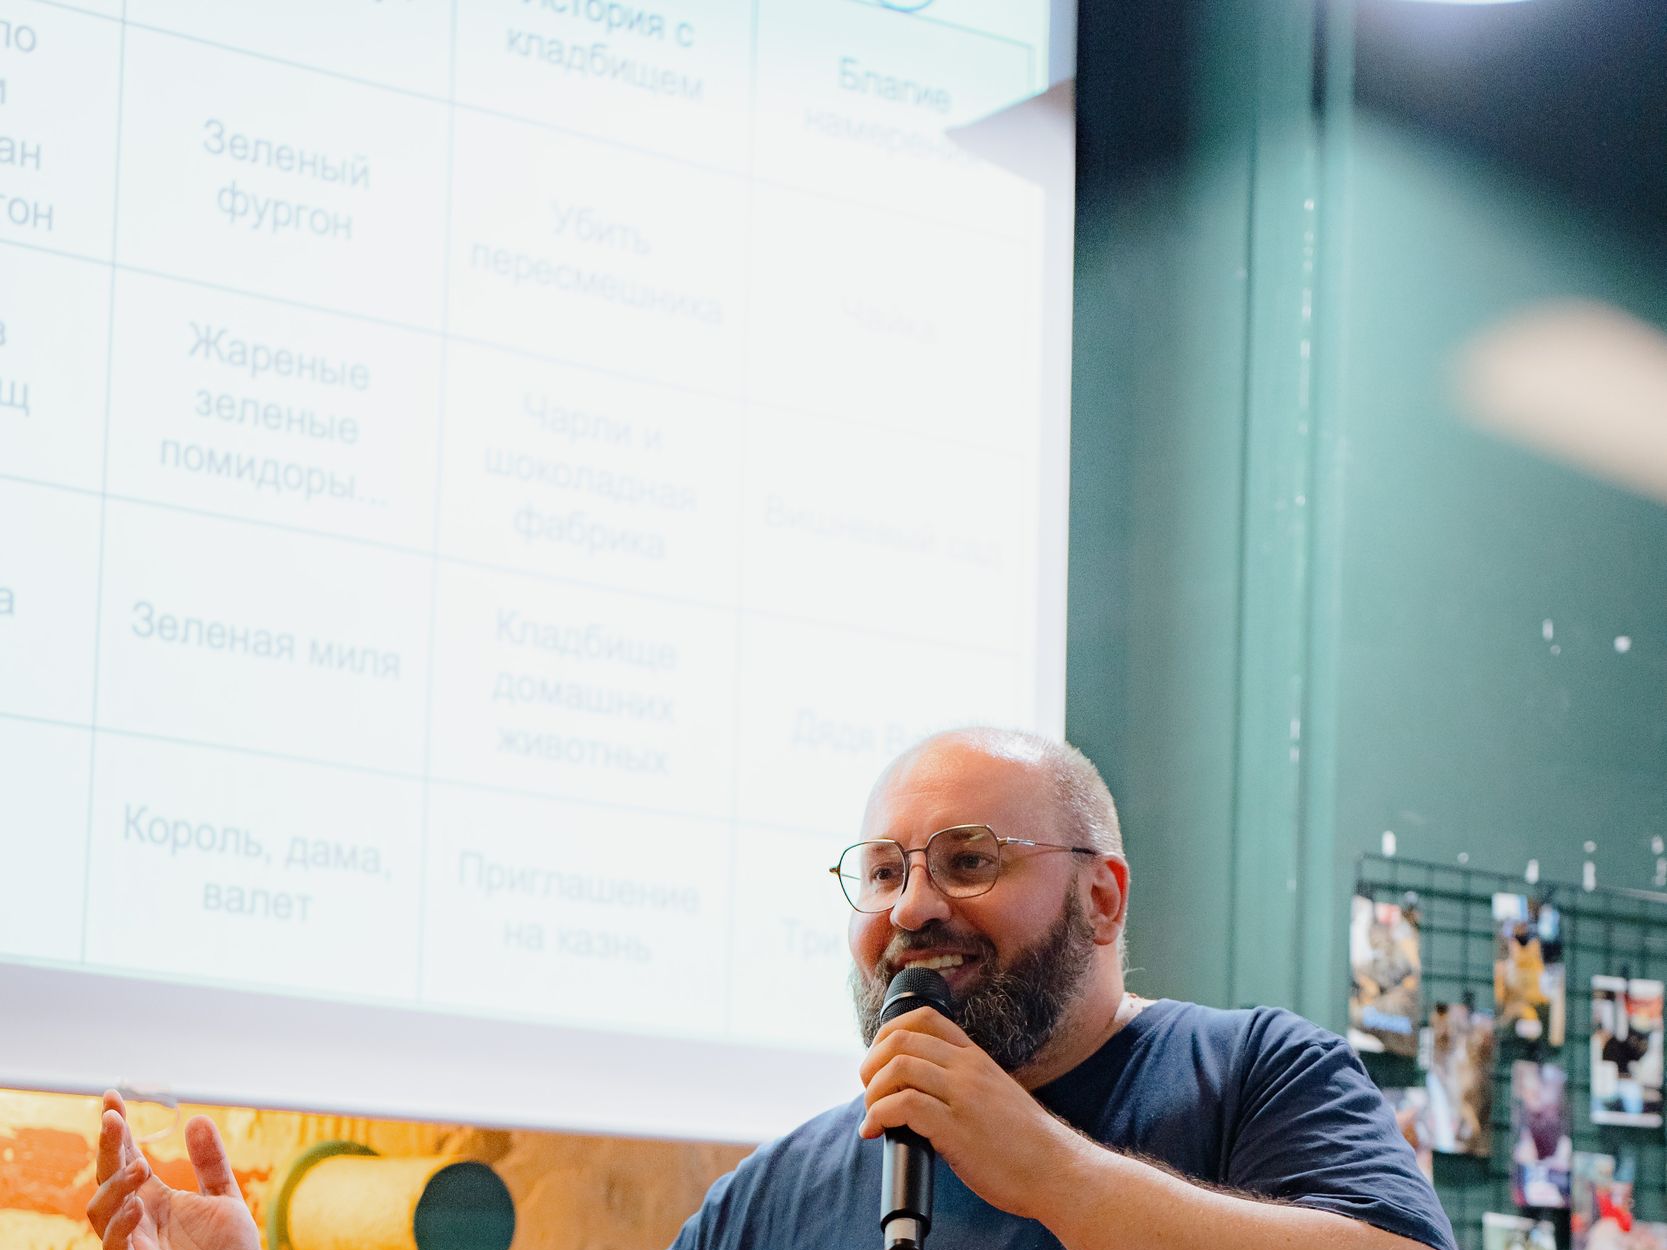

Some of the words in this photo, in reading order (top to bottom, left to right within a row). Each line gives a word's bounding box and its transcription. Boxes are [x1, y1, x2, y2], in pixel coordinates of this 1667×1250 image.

[506, 27, 703, 102] кладбищем
[674, 20, 695, 49] с
[837, 54, 953, 116] Благие
[202, 118, 371, 191] Зеленый
[216, 180, 354, 240] фургон
[548, 200, 653, 256] Убить
[469, 238, 725, 327] пересмешника
[188, 321, 371, 391] Жареные
[194, 388, 360, 446] зеленые
[522, 390, 633, 447] Чарли
[643, 424, 664, 454] и
[160, 438, 388, 508] помидоры...
[484, 445, 697, 515] шоколадная
[512, 502, 666, 561] фабрика
[131, 600, 296, 661] Зеленая
[308, 638, 401, 680] миля
[495, 608, 678, 672] Кладбище
[490, 670, 676, 726] домашних
[496, 725, 671, 778] животных
[123, 803, 272, 865] Король,
[286, 833, 393, 882] дама,
[202, 880, 313, 922] валет
[457, 848, 702, 915] Приглашение
[503, 919, 545, 952] на
[556, 925, 653, 964] казнь
